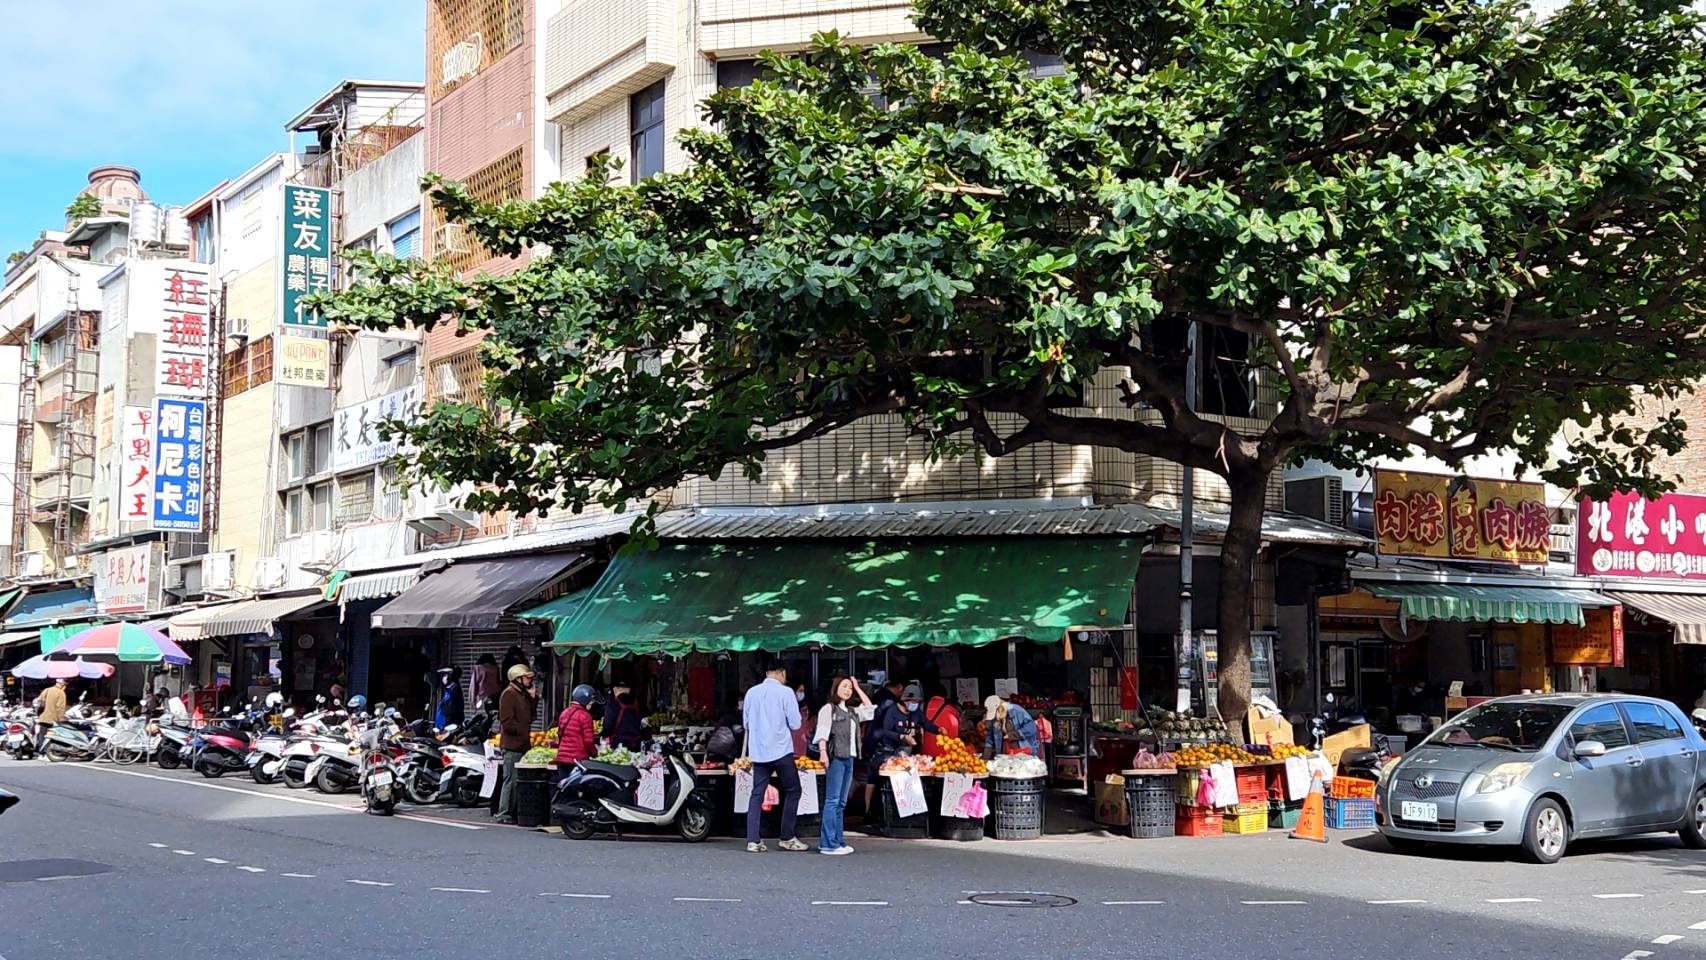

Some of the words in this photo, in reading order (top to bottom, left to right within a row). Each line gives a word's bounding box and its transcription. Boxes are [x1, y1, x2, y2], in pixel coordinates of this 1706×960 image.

[292, 190, 322, 251] 菜友
[287, 255, 306, 291] 農藥
[310, 257, 328, 290] 種子
[169, 271, 205, 390] 紅珊瑚
[283, 366, 326, 381] 杜邦農藥
[128, 410, 151, 516] 早點大王
[156, 404, 187, 515] 柯尼卡
[185, 407, 202, 516] 台灣彩色沖印
[108, 554, 146, 588] 早點大王
